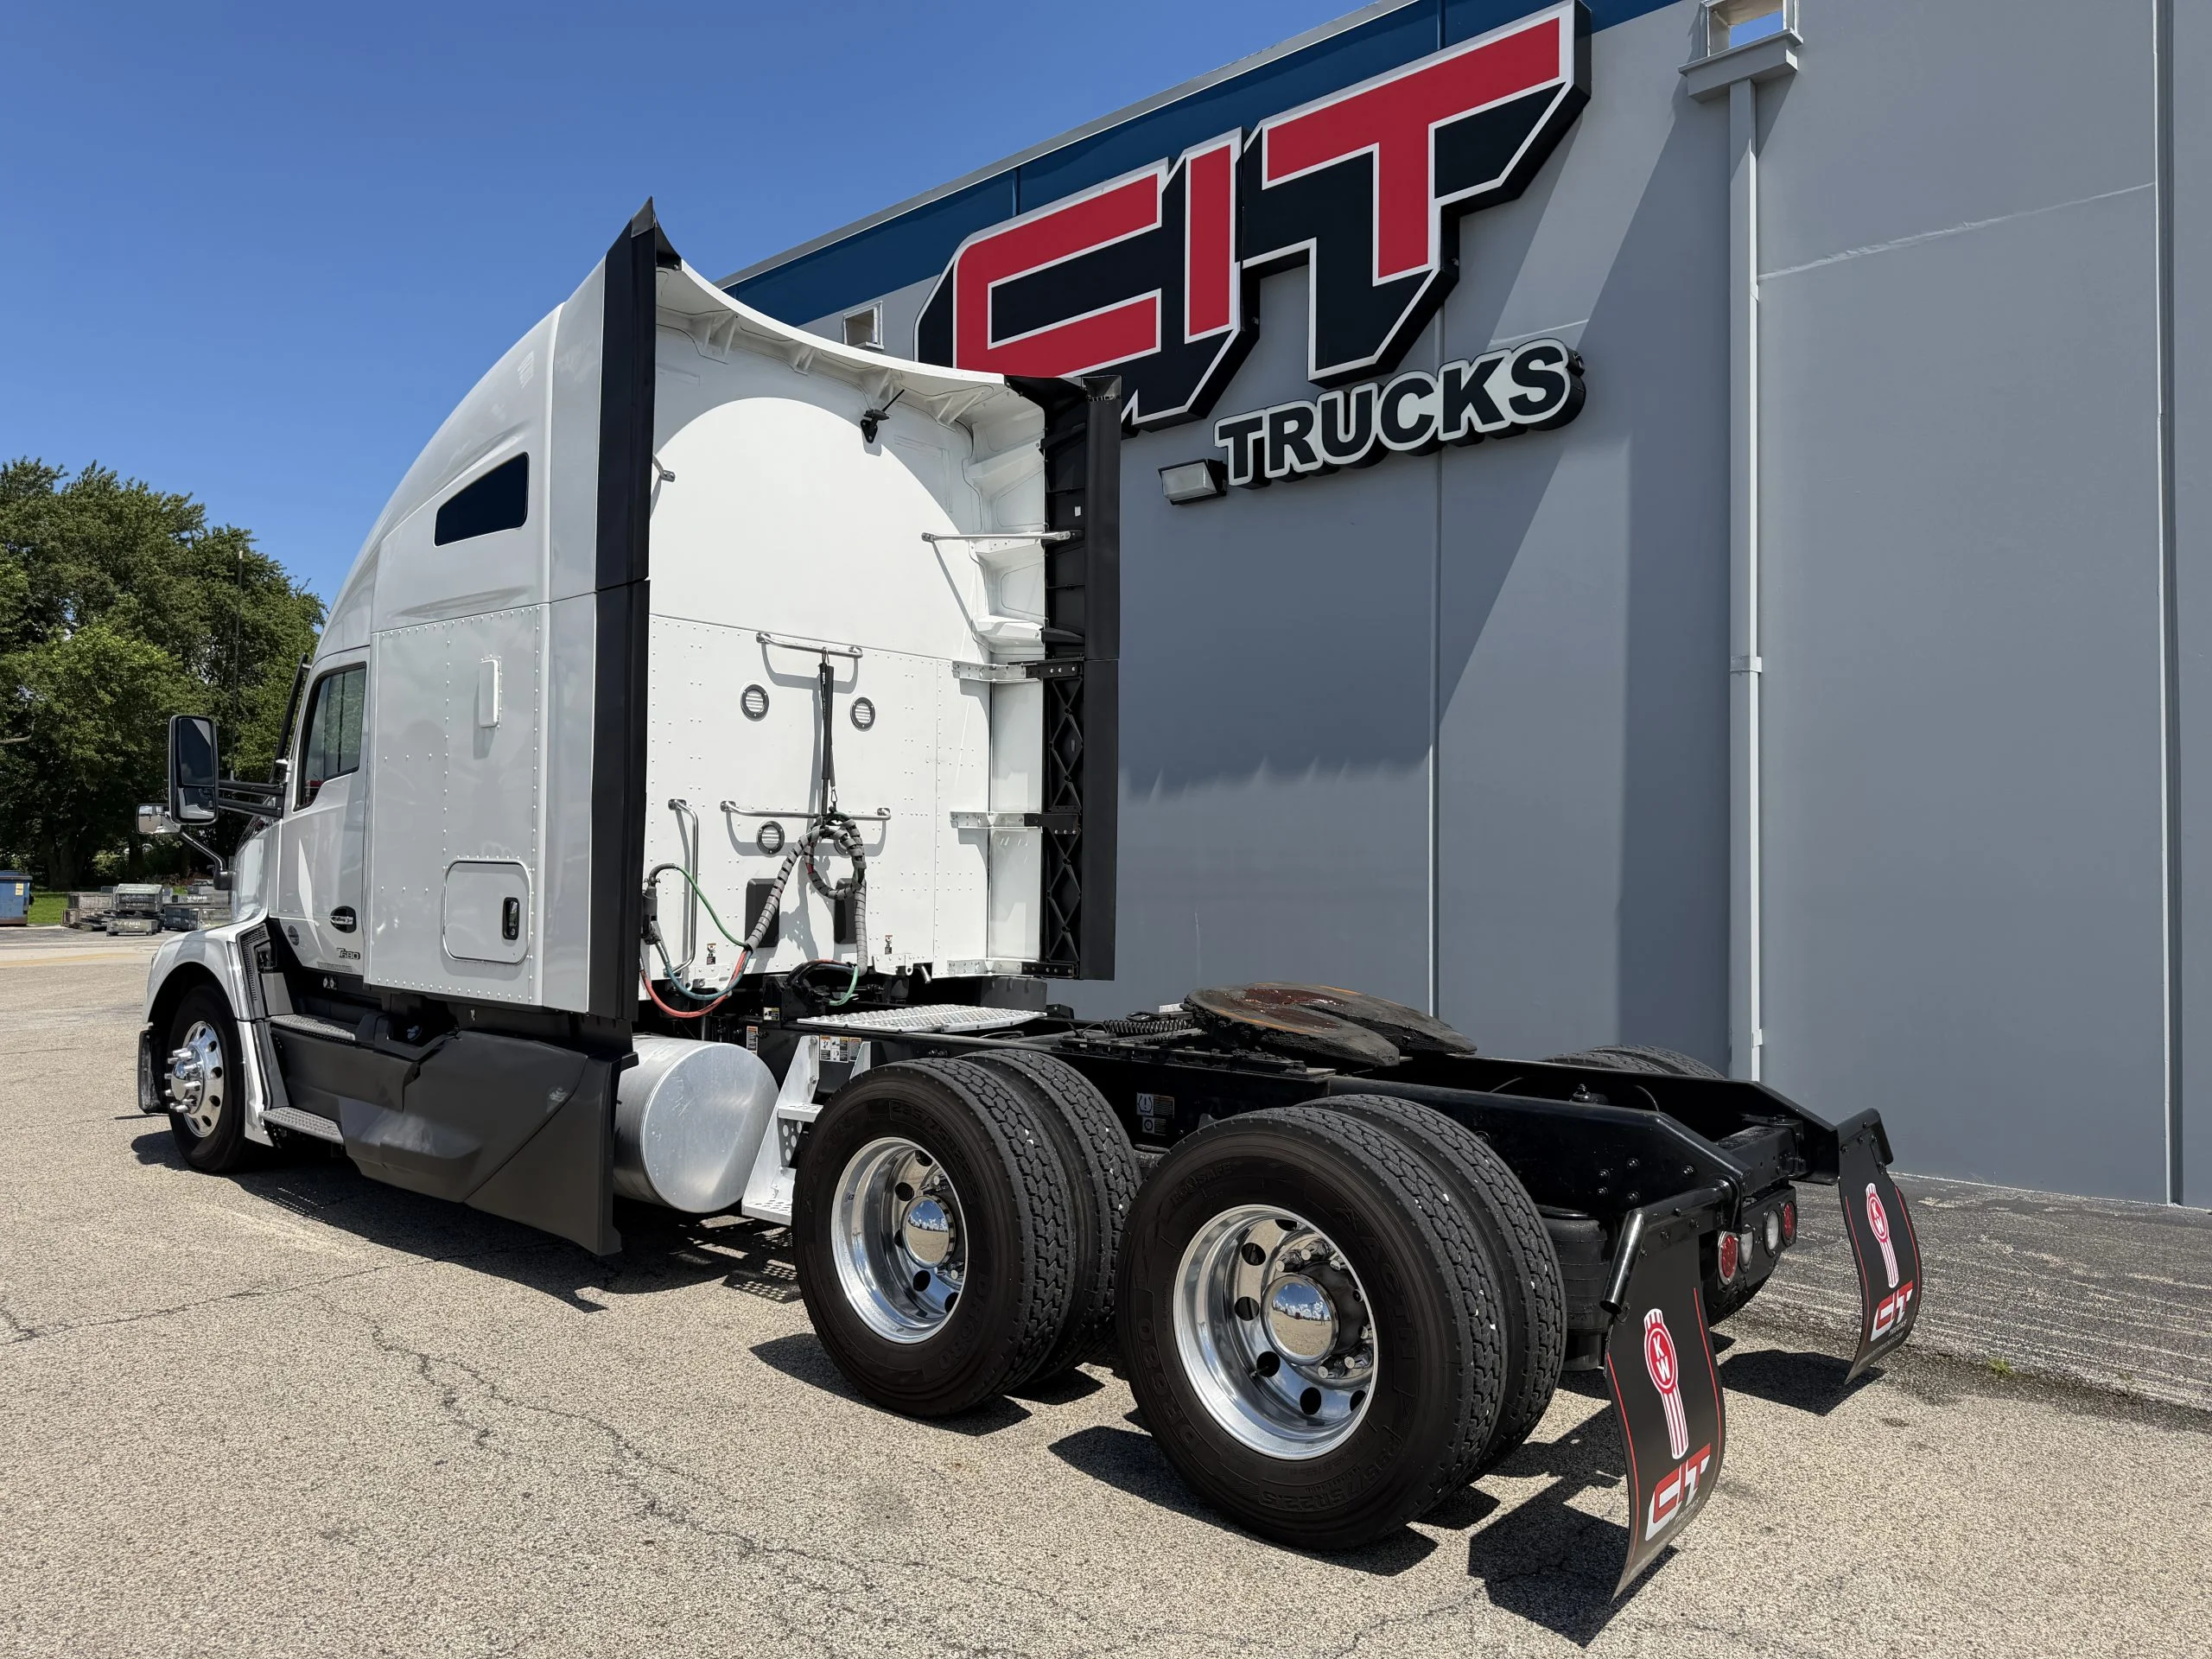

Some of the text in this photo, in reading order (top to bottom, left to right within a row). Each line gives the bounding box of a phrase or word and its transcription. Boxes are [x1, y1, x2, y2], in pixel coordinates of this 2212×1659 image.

[942, 4, 1576, 393] CIT
[1213, 339, 1573, 489] TRUCKS
[336, 947, 360, 960] T680
[1872, 1280, 1913, 1338] CIT
[1647, 1443, 1711, 1536] CIT
